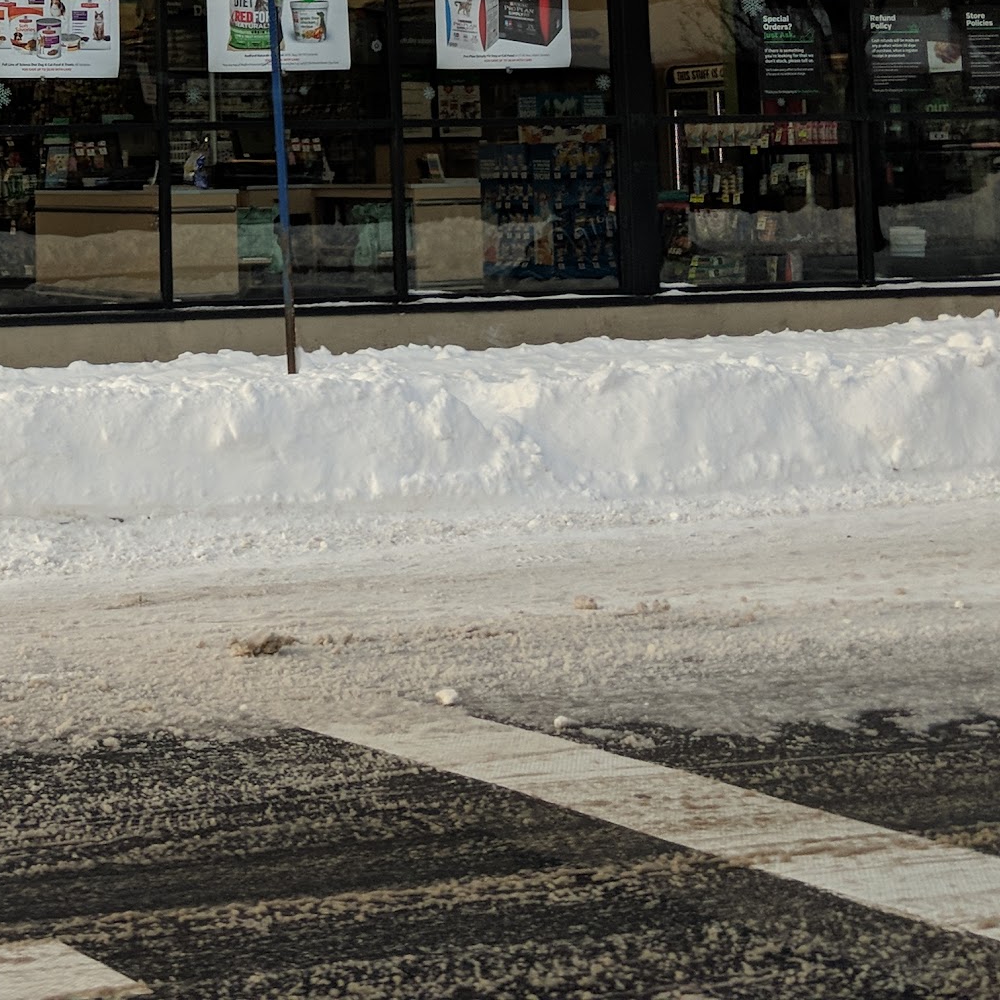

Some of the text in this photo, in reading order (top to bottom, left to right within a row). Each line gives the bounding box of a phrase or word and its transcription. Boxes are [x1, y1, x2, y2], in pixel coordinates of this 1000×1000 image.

[763, 14, 789, 23] Special
[870, 22, 892, 30] Policy
[677, 71, 690, 81] THIS
[691, 69, 709, 80] STUFF
[711, 67, 718, 78] IS
